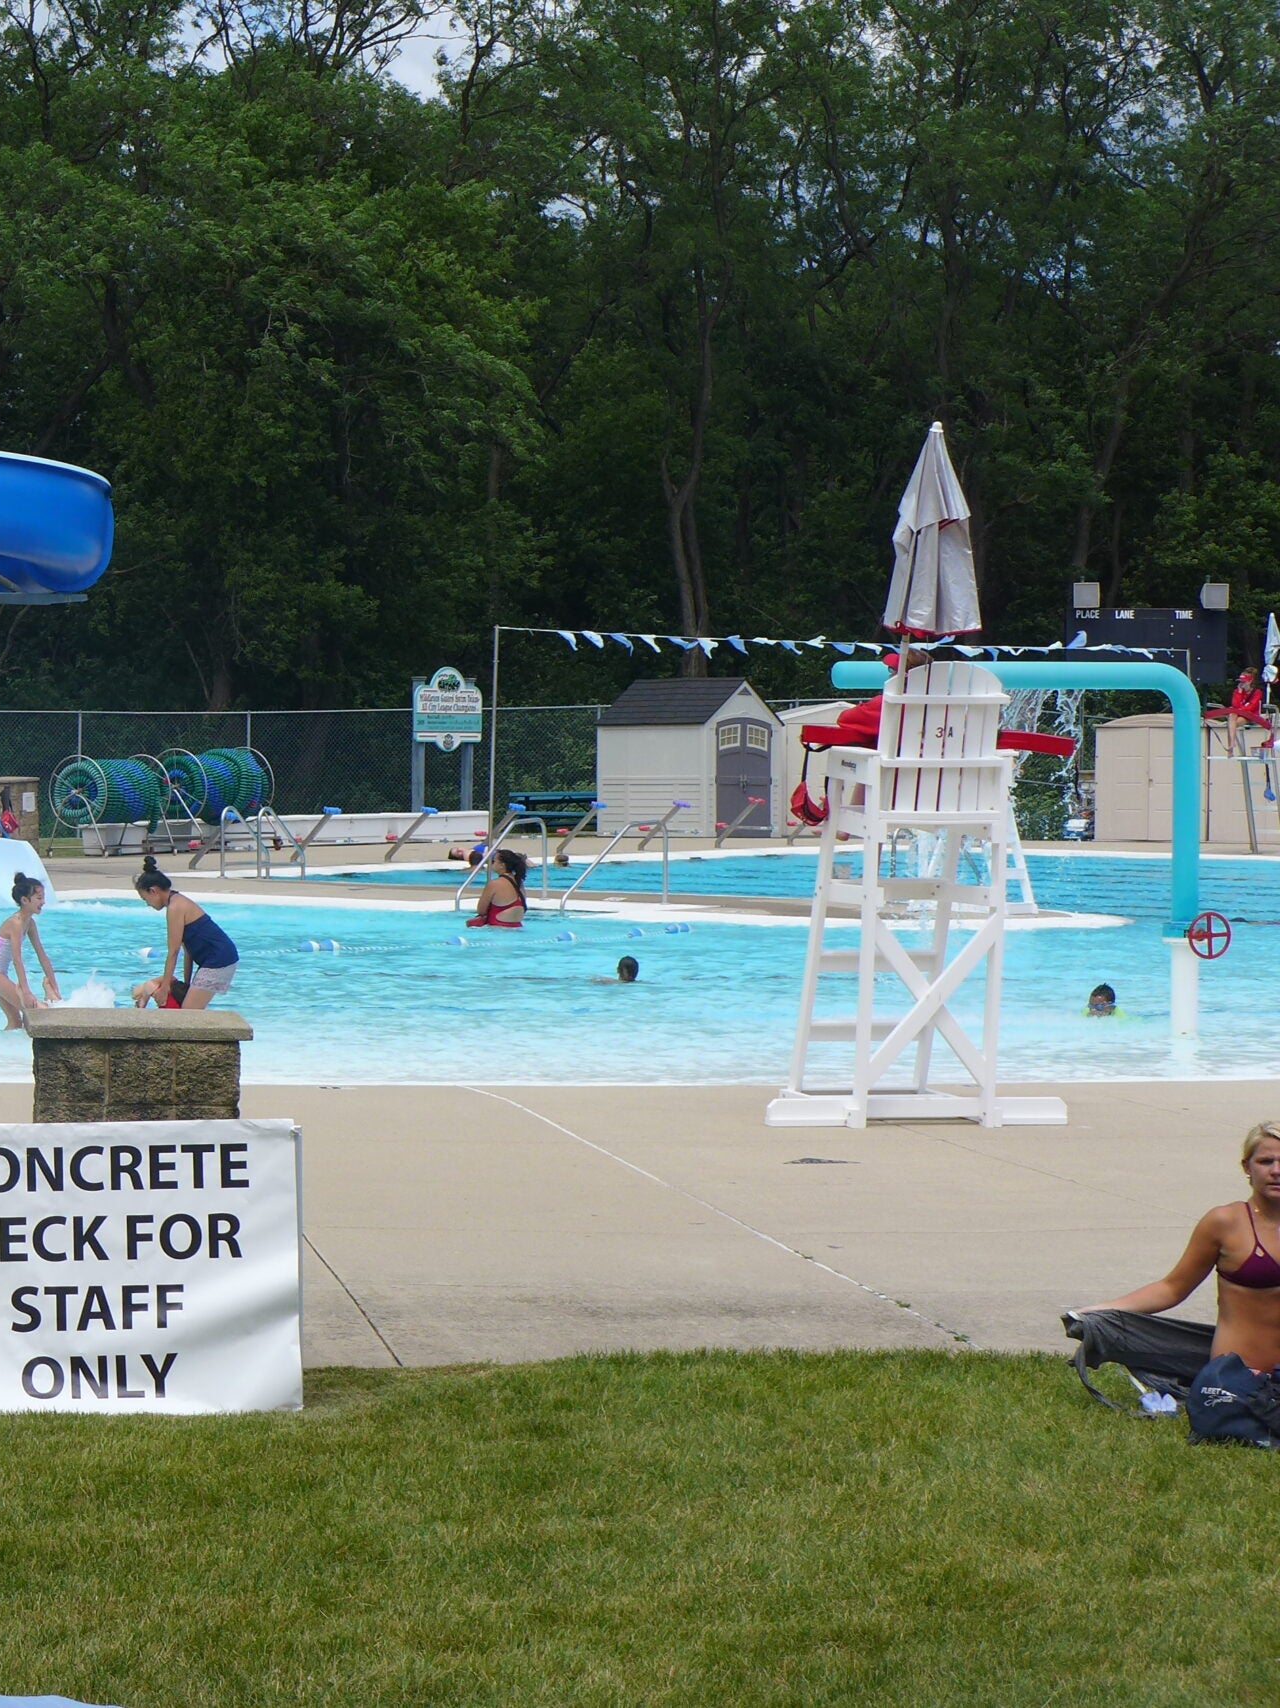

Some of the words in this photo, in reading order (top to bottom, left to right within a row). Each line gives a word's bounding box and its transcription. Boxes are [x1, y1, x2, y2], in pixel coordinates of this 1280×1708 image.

[1075, 610, 1100, 619] PLACE
[1115, 609, 1135, 619] LANE
[1175, 610, 1193, 619] TIME
[126, 1212, 243, 1261] FOR
[10, 1283, 184, 1333] STAFF
[21, 1352, 178, 1400] ONLY
